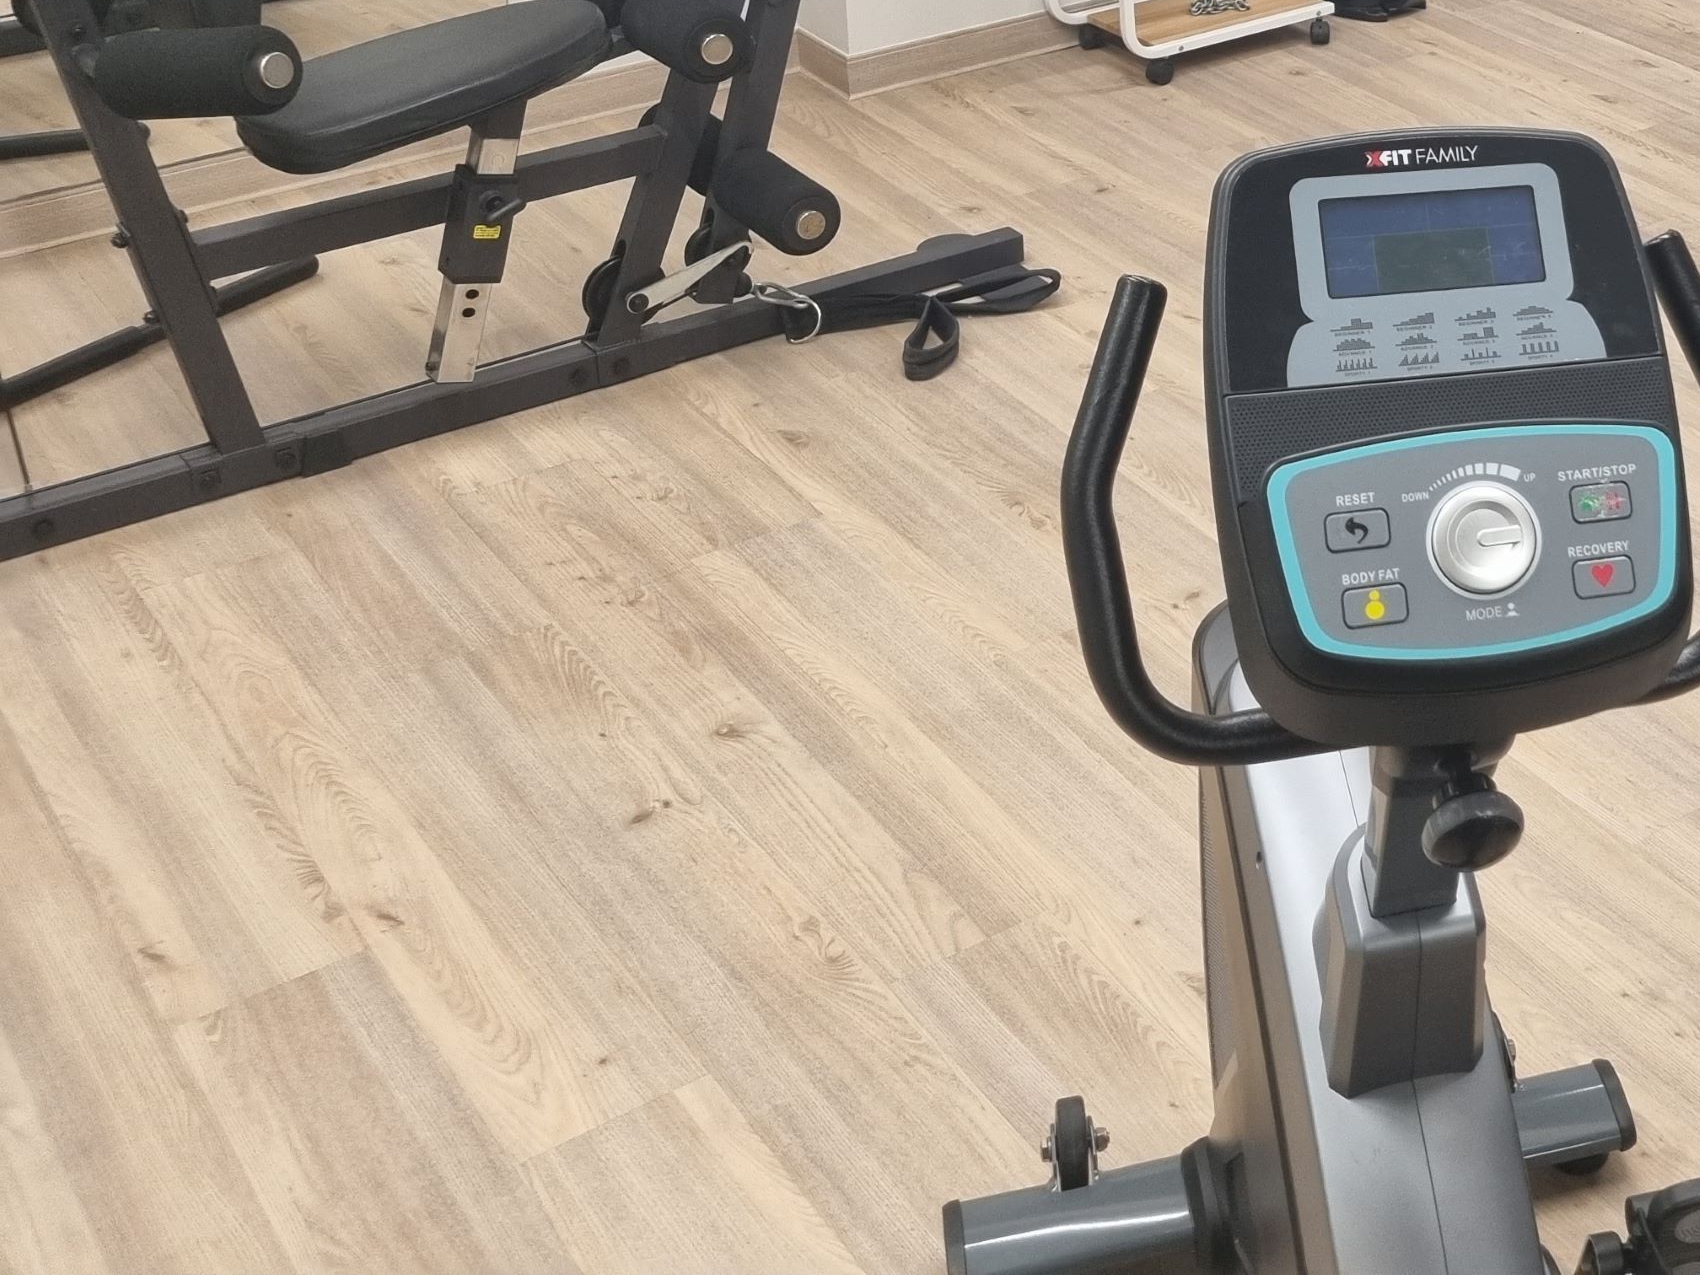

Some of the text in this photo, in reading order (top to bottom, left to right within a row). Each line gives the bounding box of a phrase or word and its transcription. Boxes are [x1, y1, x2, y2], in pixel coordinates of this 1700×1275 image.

[1364, 145, 1478, 167] XFIT FAMILY
[1523, 472, 1536, 483] UP
[1557, 463, 1637, 482] START/STOP
[1335, 491, 1376, 507] RESET
[1401, 490, 1430, 503] DOWN
[1567, 540, 1630, 558] RECOVERY
[1341, 567, 1401, 586] BODY FAT
[1465, 605, 1503, 621] MODE
